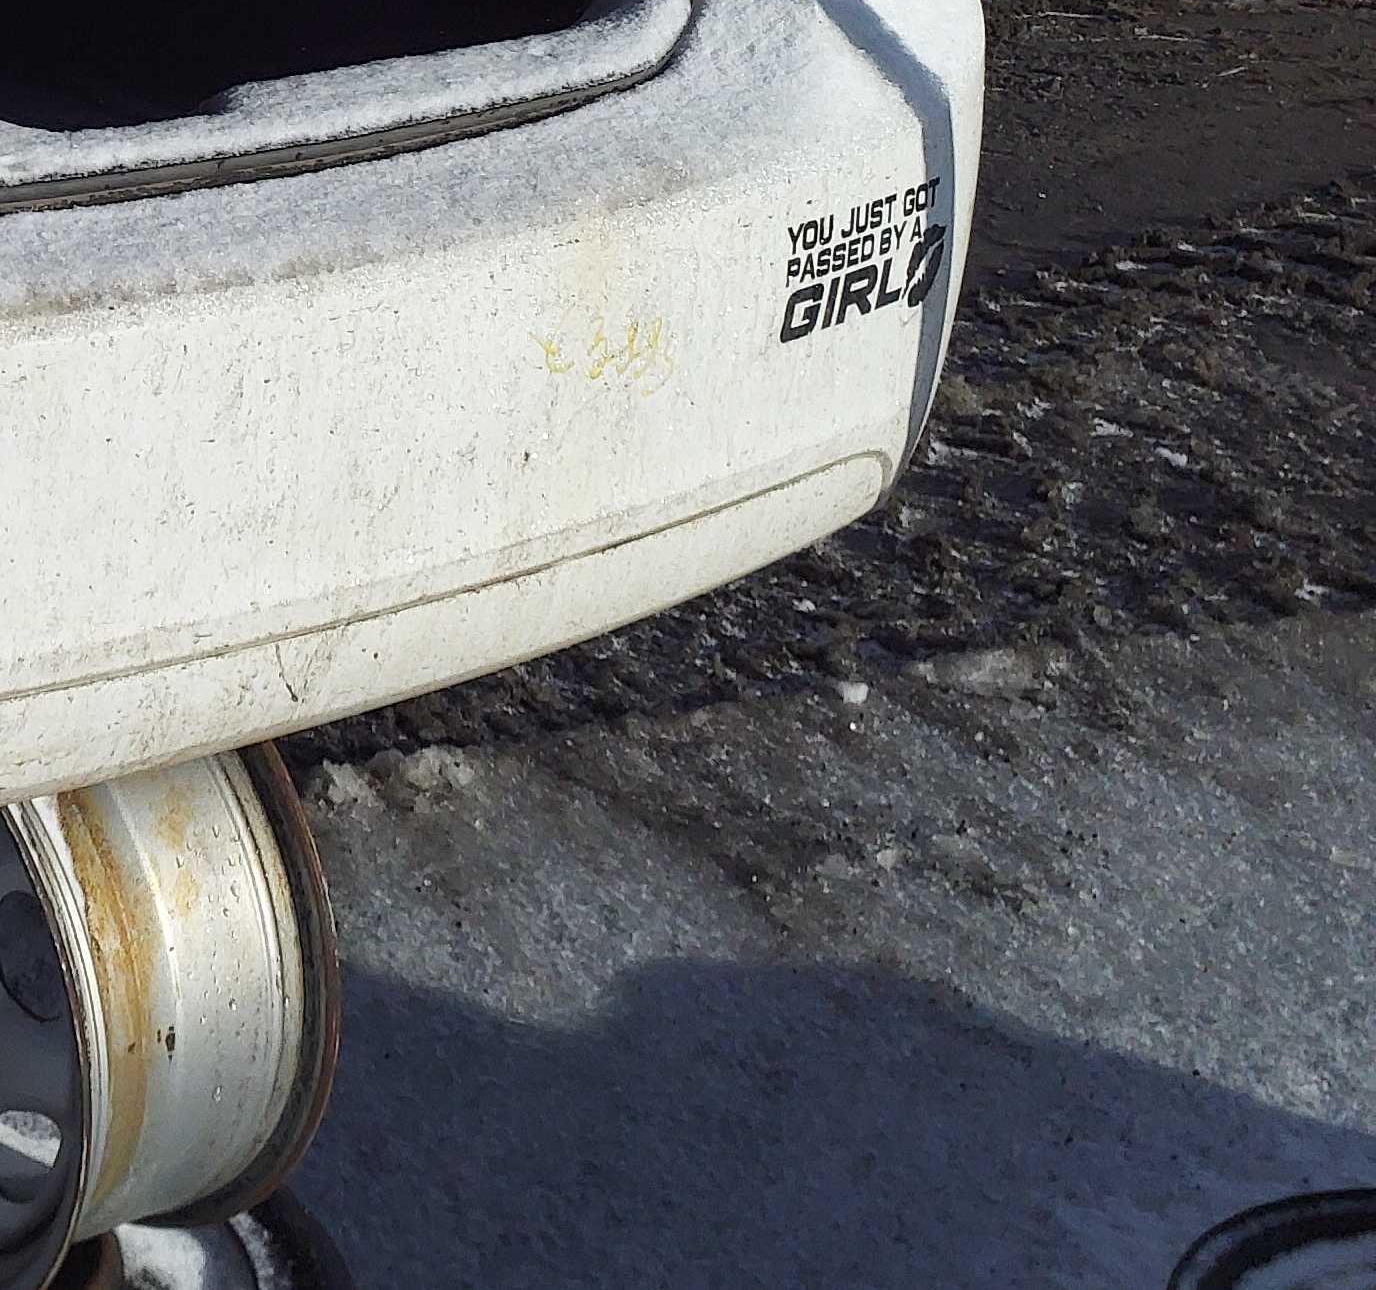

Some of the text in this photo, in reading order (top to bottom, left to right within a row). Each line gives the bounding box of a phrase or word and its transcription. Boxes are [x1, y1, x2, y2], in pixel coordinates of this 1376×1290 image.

[786, 216, 923, 287] PASSED BY A
[788, 177, 940, 254] YOU JUST GOT
[780, 257, 902, 343] GIRL
